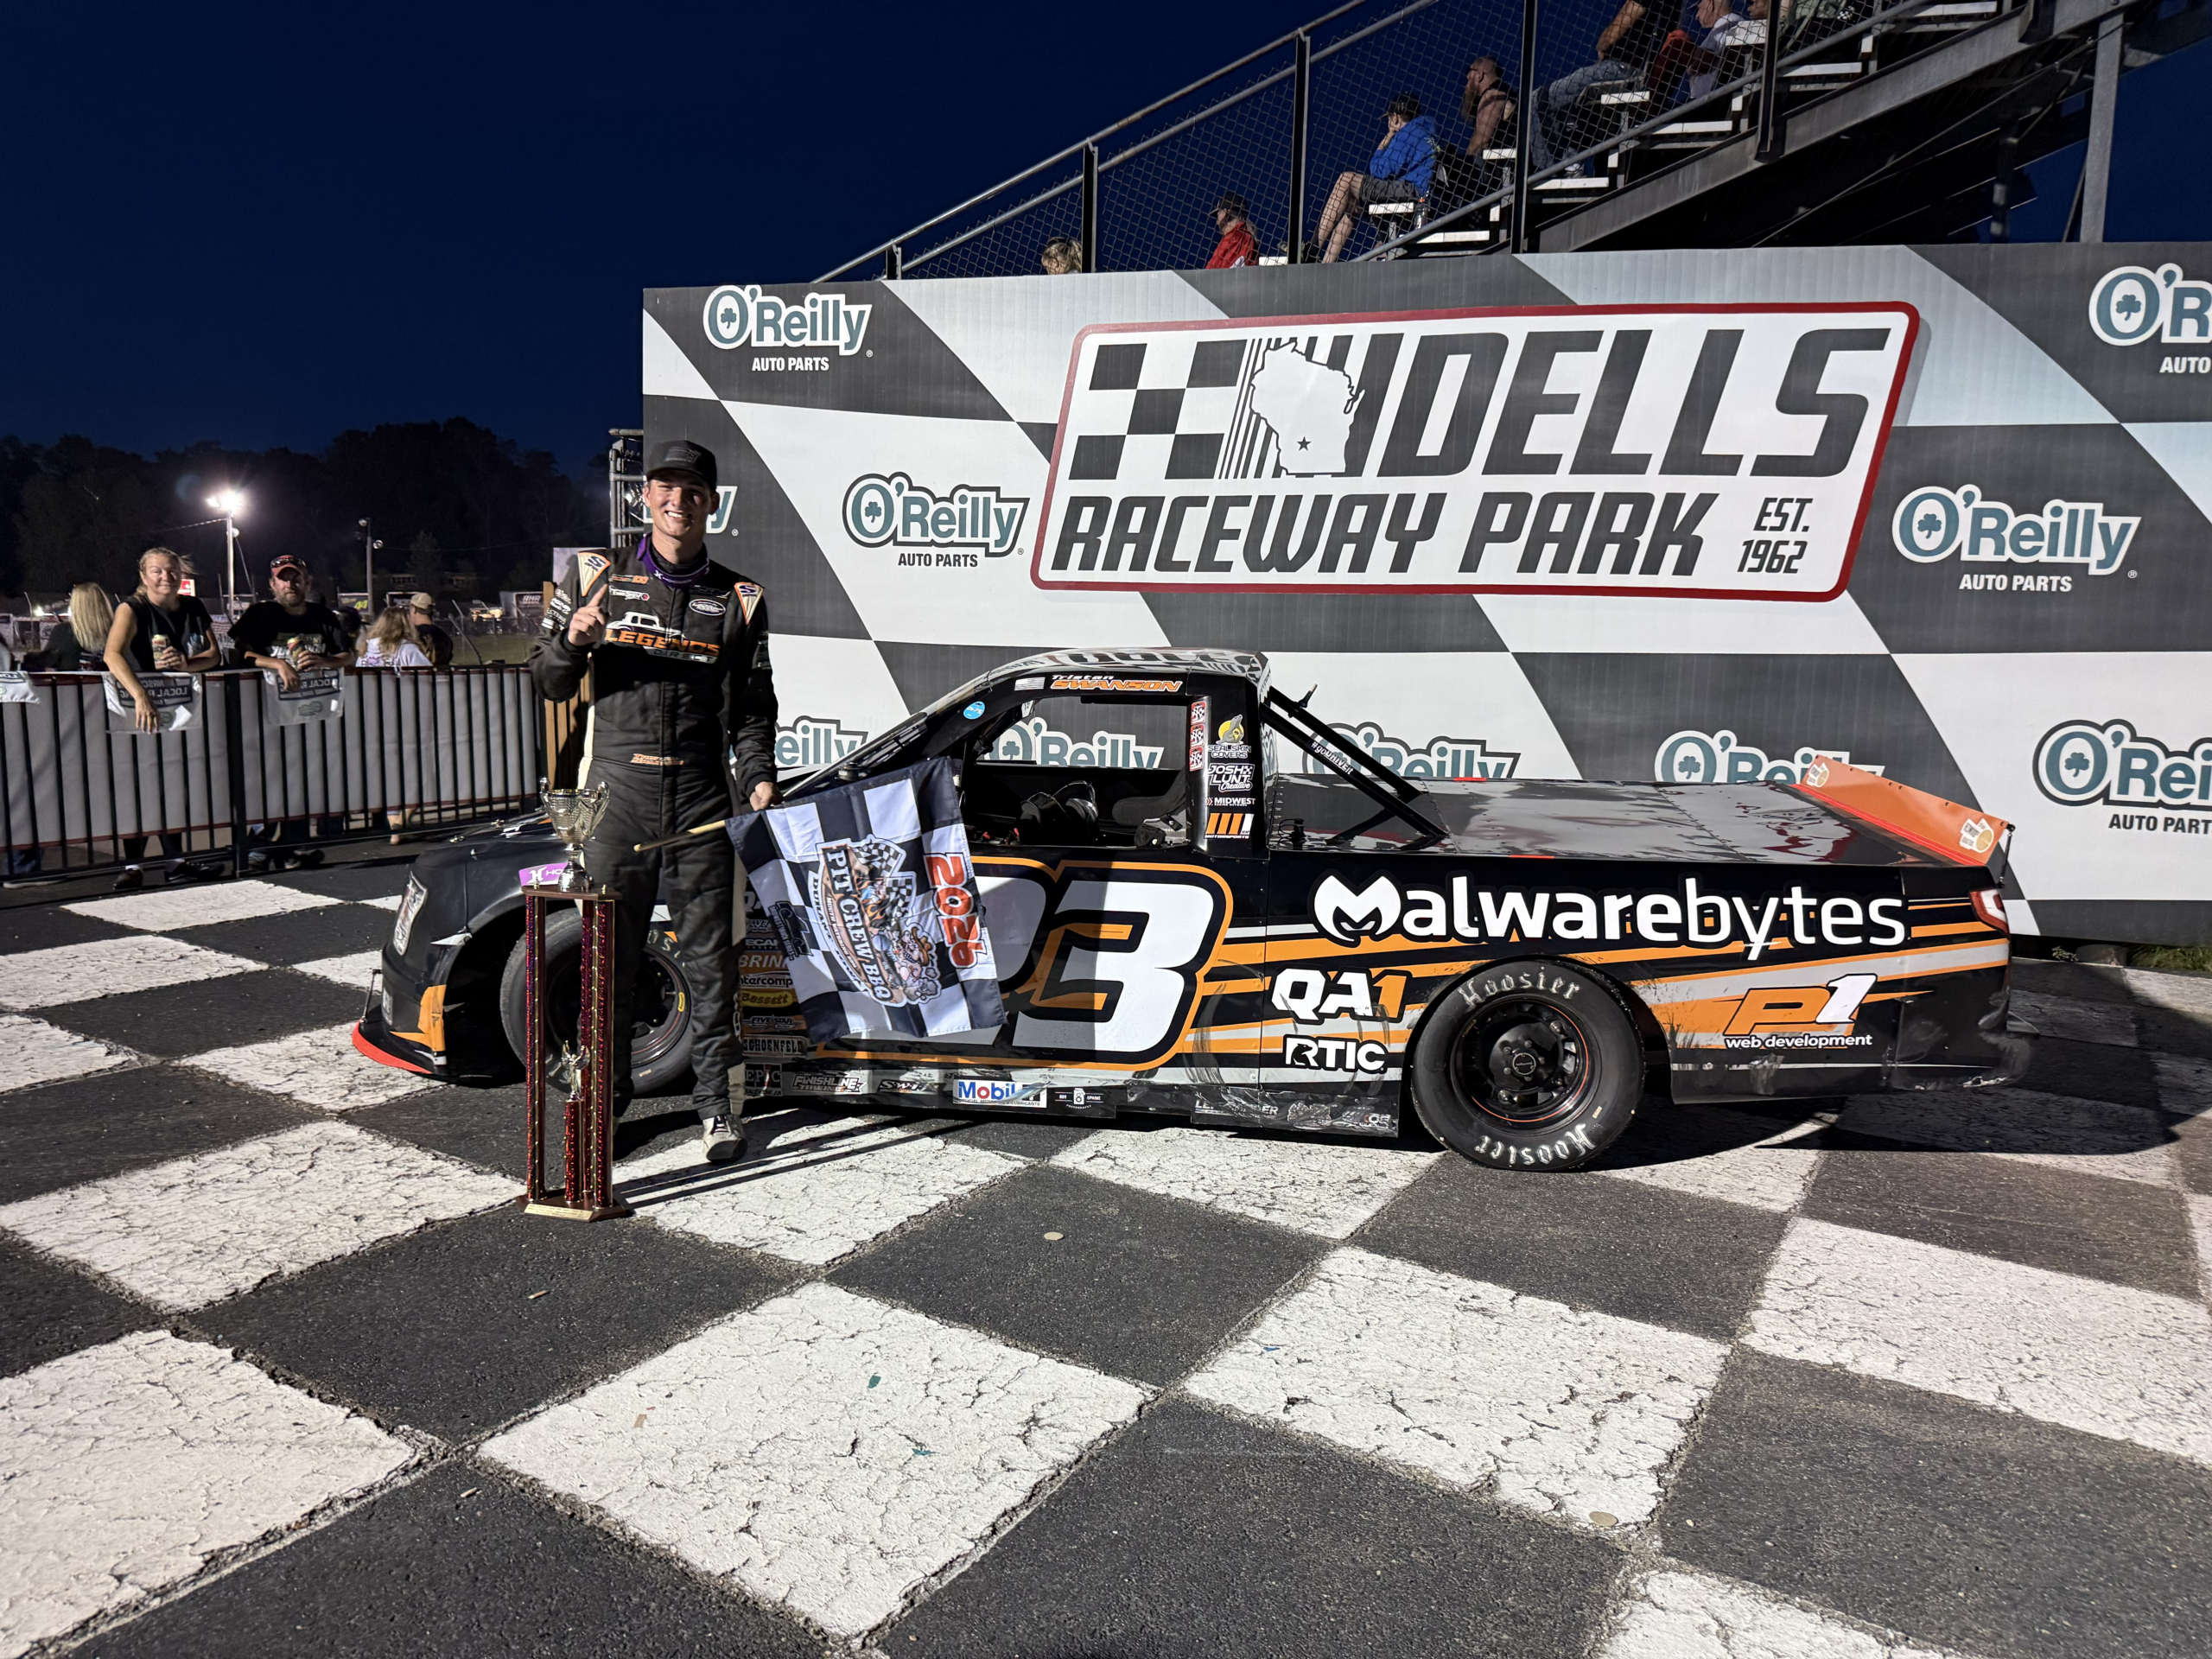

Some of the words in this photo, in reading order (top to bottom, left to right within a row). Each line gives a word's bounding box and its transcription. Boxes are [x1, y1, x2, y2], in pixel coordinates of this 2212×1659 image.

[708, 288, 866, 350] O'Reilly
[752, 358, 785, 371] AUTO
[788, 357, 829, 371] PARTS
[2160, 357, 2212, 373] AUTO
[851, 482, 1018, 548] O'Reilly
[1753, 498, 1813, 532] EST.
[1898, 491, 2133, 570] O'Reilly
[1051, 493, 1447, 573] RACEWAY
[1459, 492, 1719, 576] PARK
[898, 553, 931, 566] AUTO
[936, 554, 978, 567] PARTS
[1737, 540, 1807, 574] 1962
[1959, 574, 2007, 590] AUTO
[2012, 575, 2072, 592] PARTS
[654, 649, 714, 662] DIRECT
[1051, 680, 1183, 691] SWANSON
[1208, 766, 1243, 774] JOSH
[1212, 774, 1250, 783] LUNT
[2108, 814, 2158, 831] AUTO
[2163, 817, 2212, 835] PART
[826, 850, 854, 894] PIT
[925, 854, 987, 968] 2026
[1314, 875, 1904, 960] Malwarebytes
[838, 896, 874, 963] CREW
[740, 976, 793, 988] ntercomp
[741, 993, 788, 1004] Bassett
[866, 963, 893, 1001] BBQ
[1271, 968, 1407, 1020] QA1
[1458, 966, 1580, 1007] Hoosier
[1723, 974, 1878, 1036] P1
[743, 1039, 803, 1052] SCHOENFELD
[1285, 1037, 1386, 1071] RTIC
[1726, 1037, 1762, 1048] web
[1765, 1035, 1872, 1049] development
[794, 1074, 857, 1088] FINISHLINE
[958, 1081, 1015, 1100] Mobil
[1474, 1123, 1597, 1168] Hoosier
